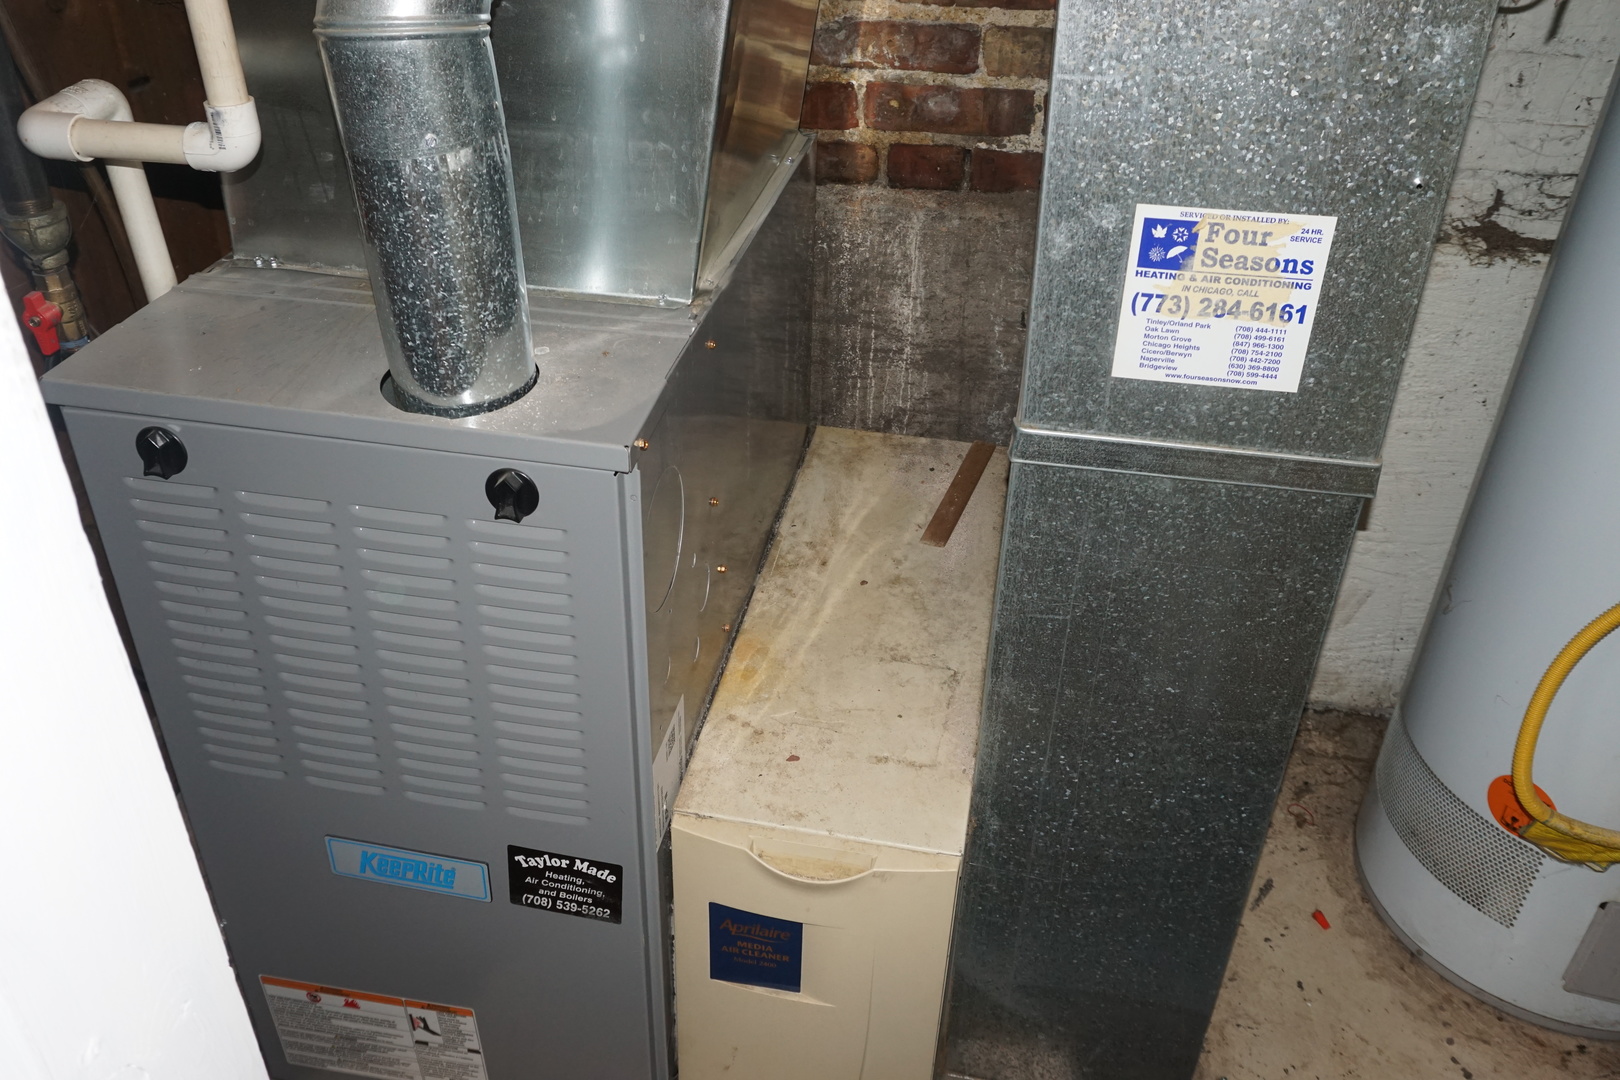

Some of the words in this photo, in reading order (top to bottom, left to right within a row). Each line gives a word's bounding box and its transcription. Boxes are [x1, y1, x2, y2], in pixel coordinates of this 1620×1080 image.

[1180, 211, 1218, 220] SERVICED
[1232, 215, 1276, 224] INSTALLED
[1204, 221, 1273, 247] Four
[1290, 235, 1323, 244] SERVICE
[1200, 247, 1314, 275] Seasons
[1135, 269, 1185, 281] HEATING
[1188, 273, 1198, 282] &
[1200, 275, 1221, 285] AIR
[1224, 276, 1312, 291] CONDITIONING
[1181, 285, 1192, 293] IN
[1194, 286, 1235, 297] CHICAGO,
[1237, 289, 1260, 298] CALL
[1131, 292, 1191, 320] (773)
[1197, 297, 1308, 325] 284-6161
[1144, 325, 1159, 333] Oak
[1146, 318, 1193, 328] Tinley/Orland
[1235, 325, 1254, 333] (708)
[1255, 327, 1287, 335] 444-1111
[1143, 333, 1169, 341] Morton
[1170, 335, 1192, 343] Grove
[1234, 333, 1252, 341] (708)
[1253, 335, 1285, 343] 499-6161
[1142, 340, 1171, 349] Chicago
[1173, 343, 1201, 351] Heights
[1232, 340, 1251, 348] (847)
[1252, 342, 1284, 350] 966-1300
[1140, 355, 1175, 363] Naperville
[1141, 348, 1192, 358] Cicero/Berwyn
[1231, 348, 1249, 356] (708)
[1251, 349, 1283, 358] 754-2100
[1229, 355, 1247, 363] (708)
[1249, 357, 1281, 365] 442-7200
[1139, 362, 1178, 371] Bridgeview
[1247, 364, 1279, 373] 369-8800
[1165, 373, 1258, 385] www.fourseasonsnow.com
[1226, 370, 1245, 378] (708)
[1246, 372, 1278, 380] 599-4444
[359, 850, 456, 889] KeepRite
[514, 854, 570, 869] Taylor
[573, 858, 617, 884] Made
[545, 870, 585, 885] Heating,
[525, 876, 539, 885] Air
[541, 878, 606, 898] Conditioning,
[538, 888, 557, 897] and
[559, 891, 593, 904] Boilers
[522, 893, 552, 909] (708)
[556, 900, 611, 919] 539-5262
[720, 918, 791, 940] Aprilaire
[737, 940, 773, 952] MEDIA
[721, 945, 739, 954] AIR
[741, 948, 790, 962] CLEANER
